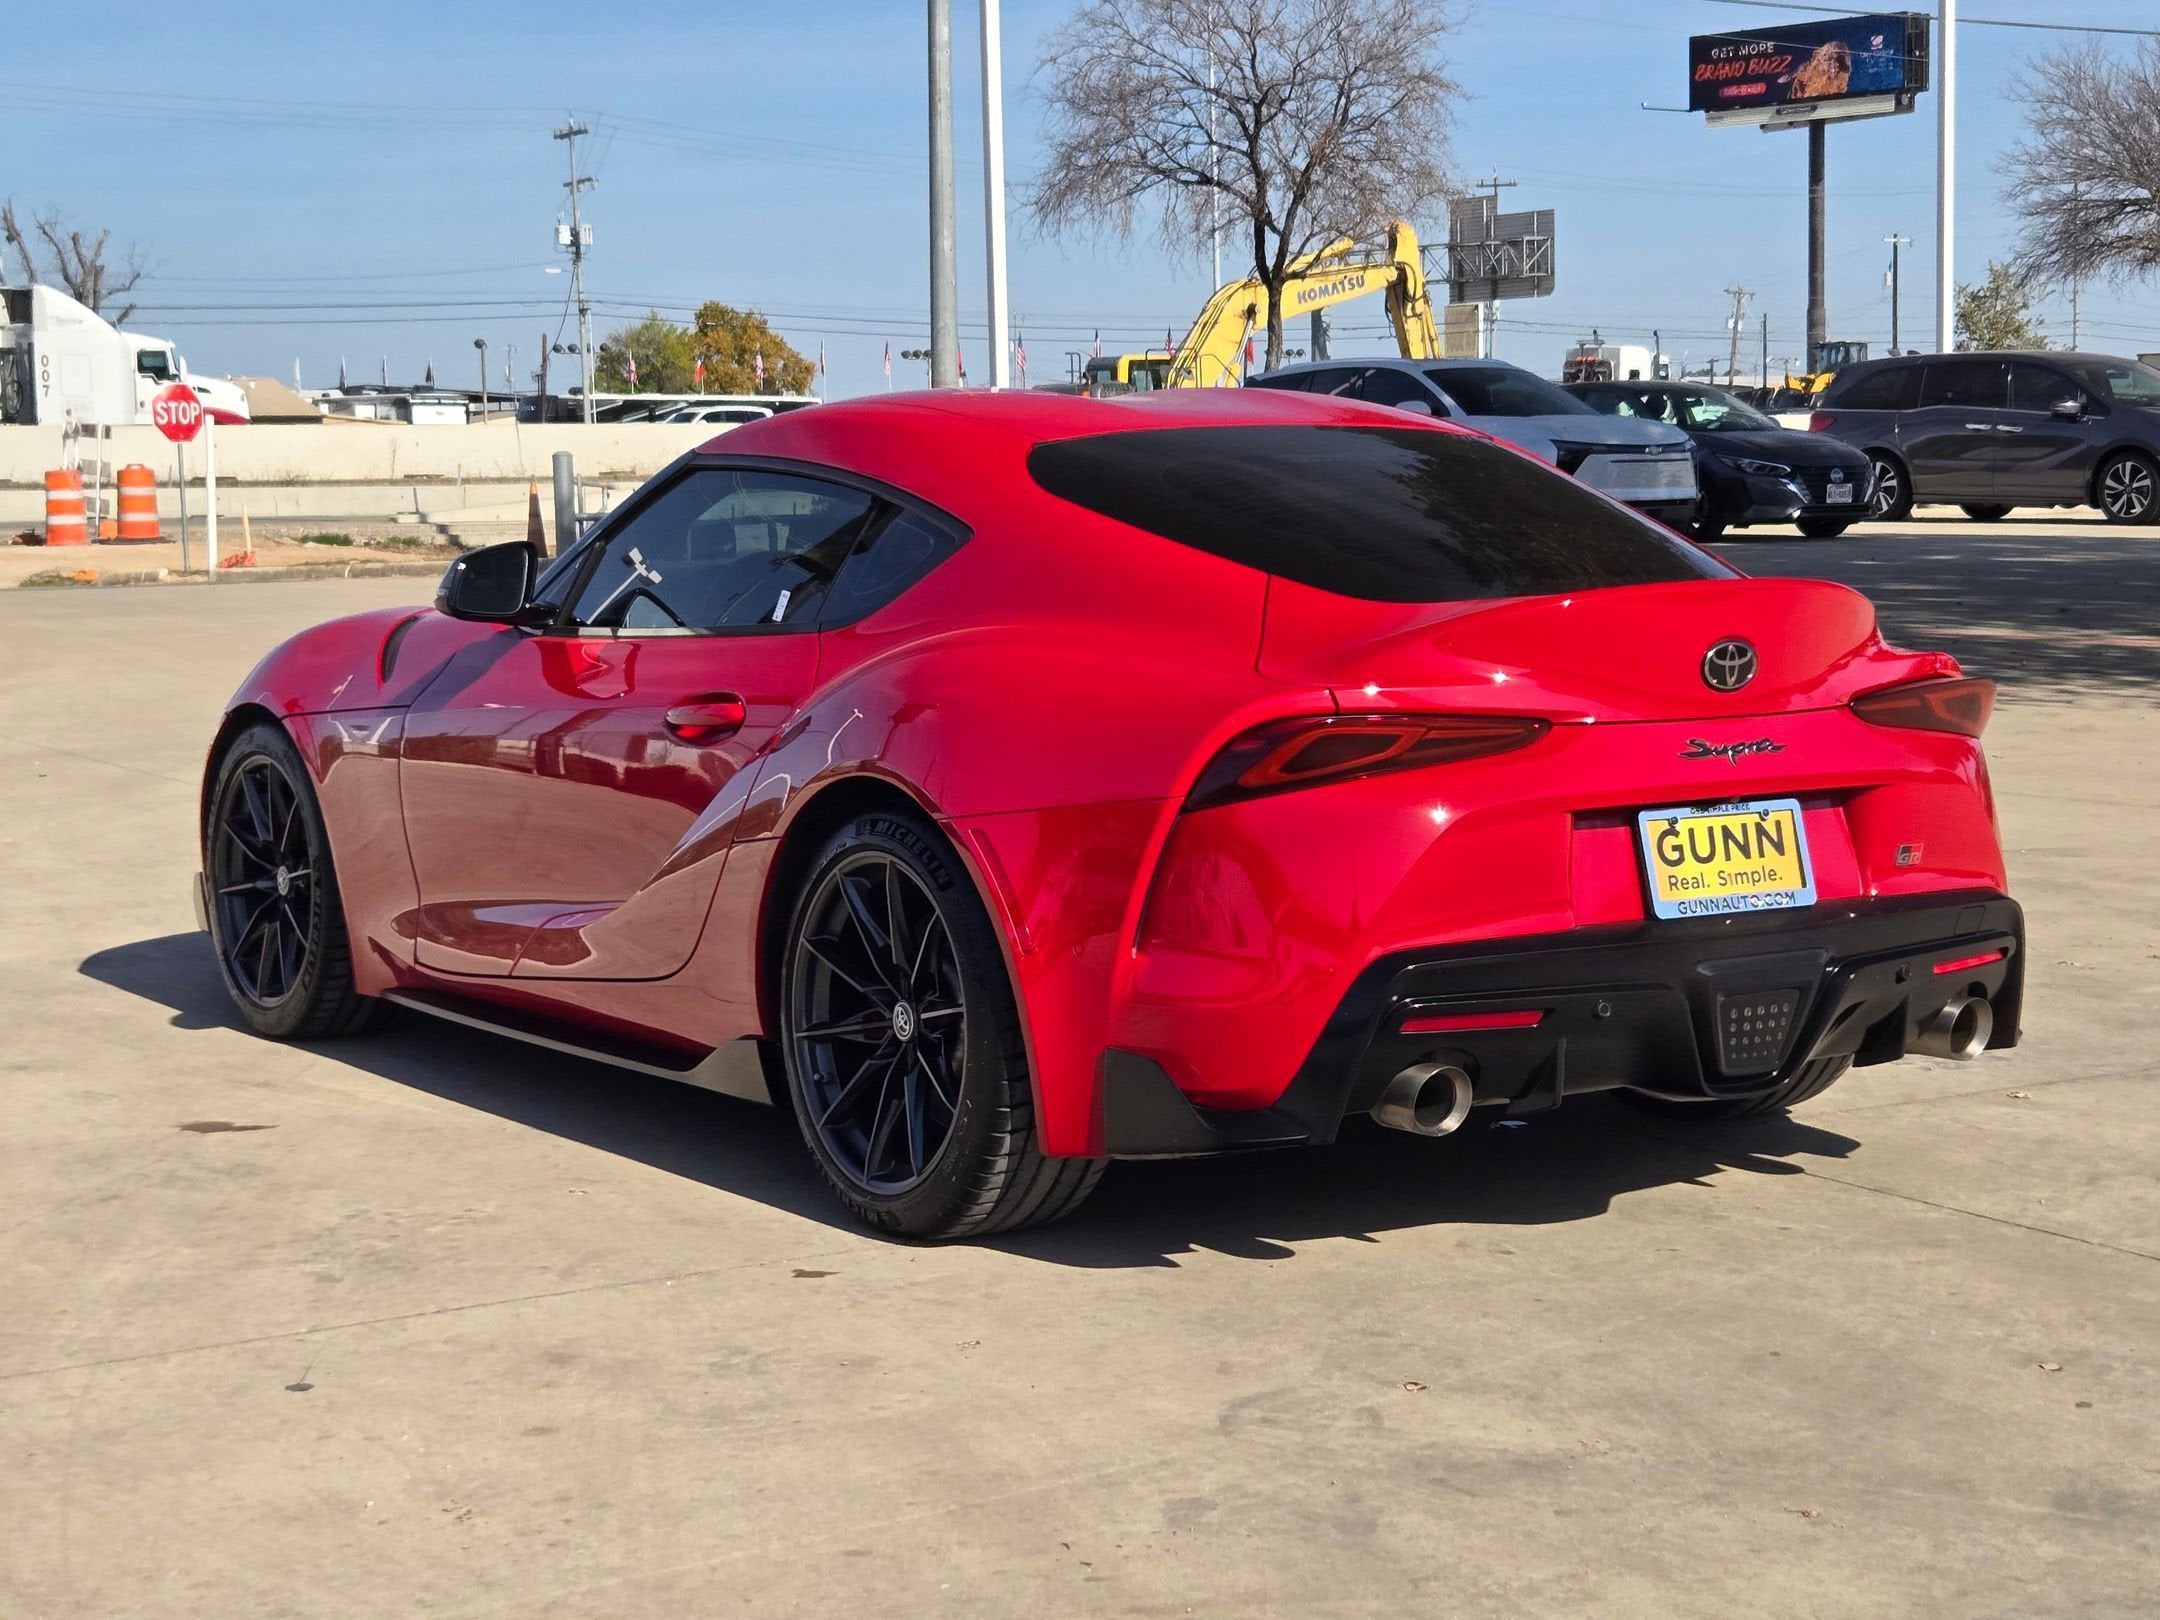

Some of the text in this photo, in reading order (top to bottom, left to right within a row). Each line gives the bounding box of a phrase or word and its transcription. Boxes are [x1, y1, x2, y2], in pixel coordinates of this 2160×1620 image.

[1711, 42, 1776, 59] GET MORE
[1694, 54, 1793, 82] BRAND BUZZ
[1297, 274, 1366, 305] KOMATSU
[156, 400, 201, 425] STOP
[1677, 737, 1788, 768] Supra
[873, 820, 950, 886] MICHELIN
[1656, 819, 1786, 868] GUNN
[1668, 866, 1783, 892] Real. Simple.
[1677, 891, 1797, 916] GUNNAUTO.COM
